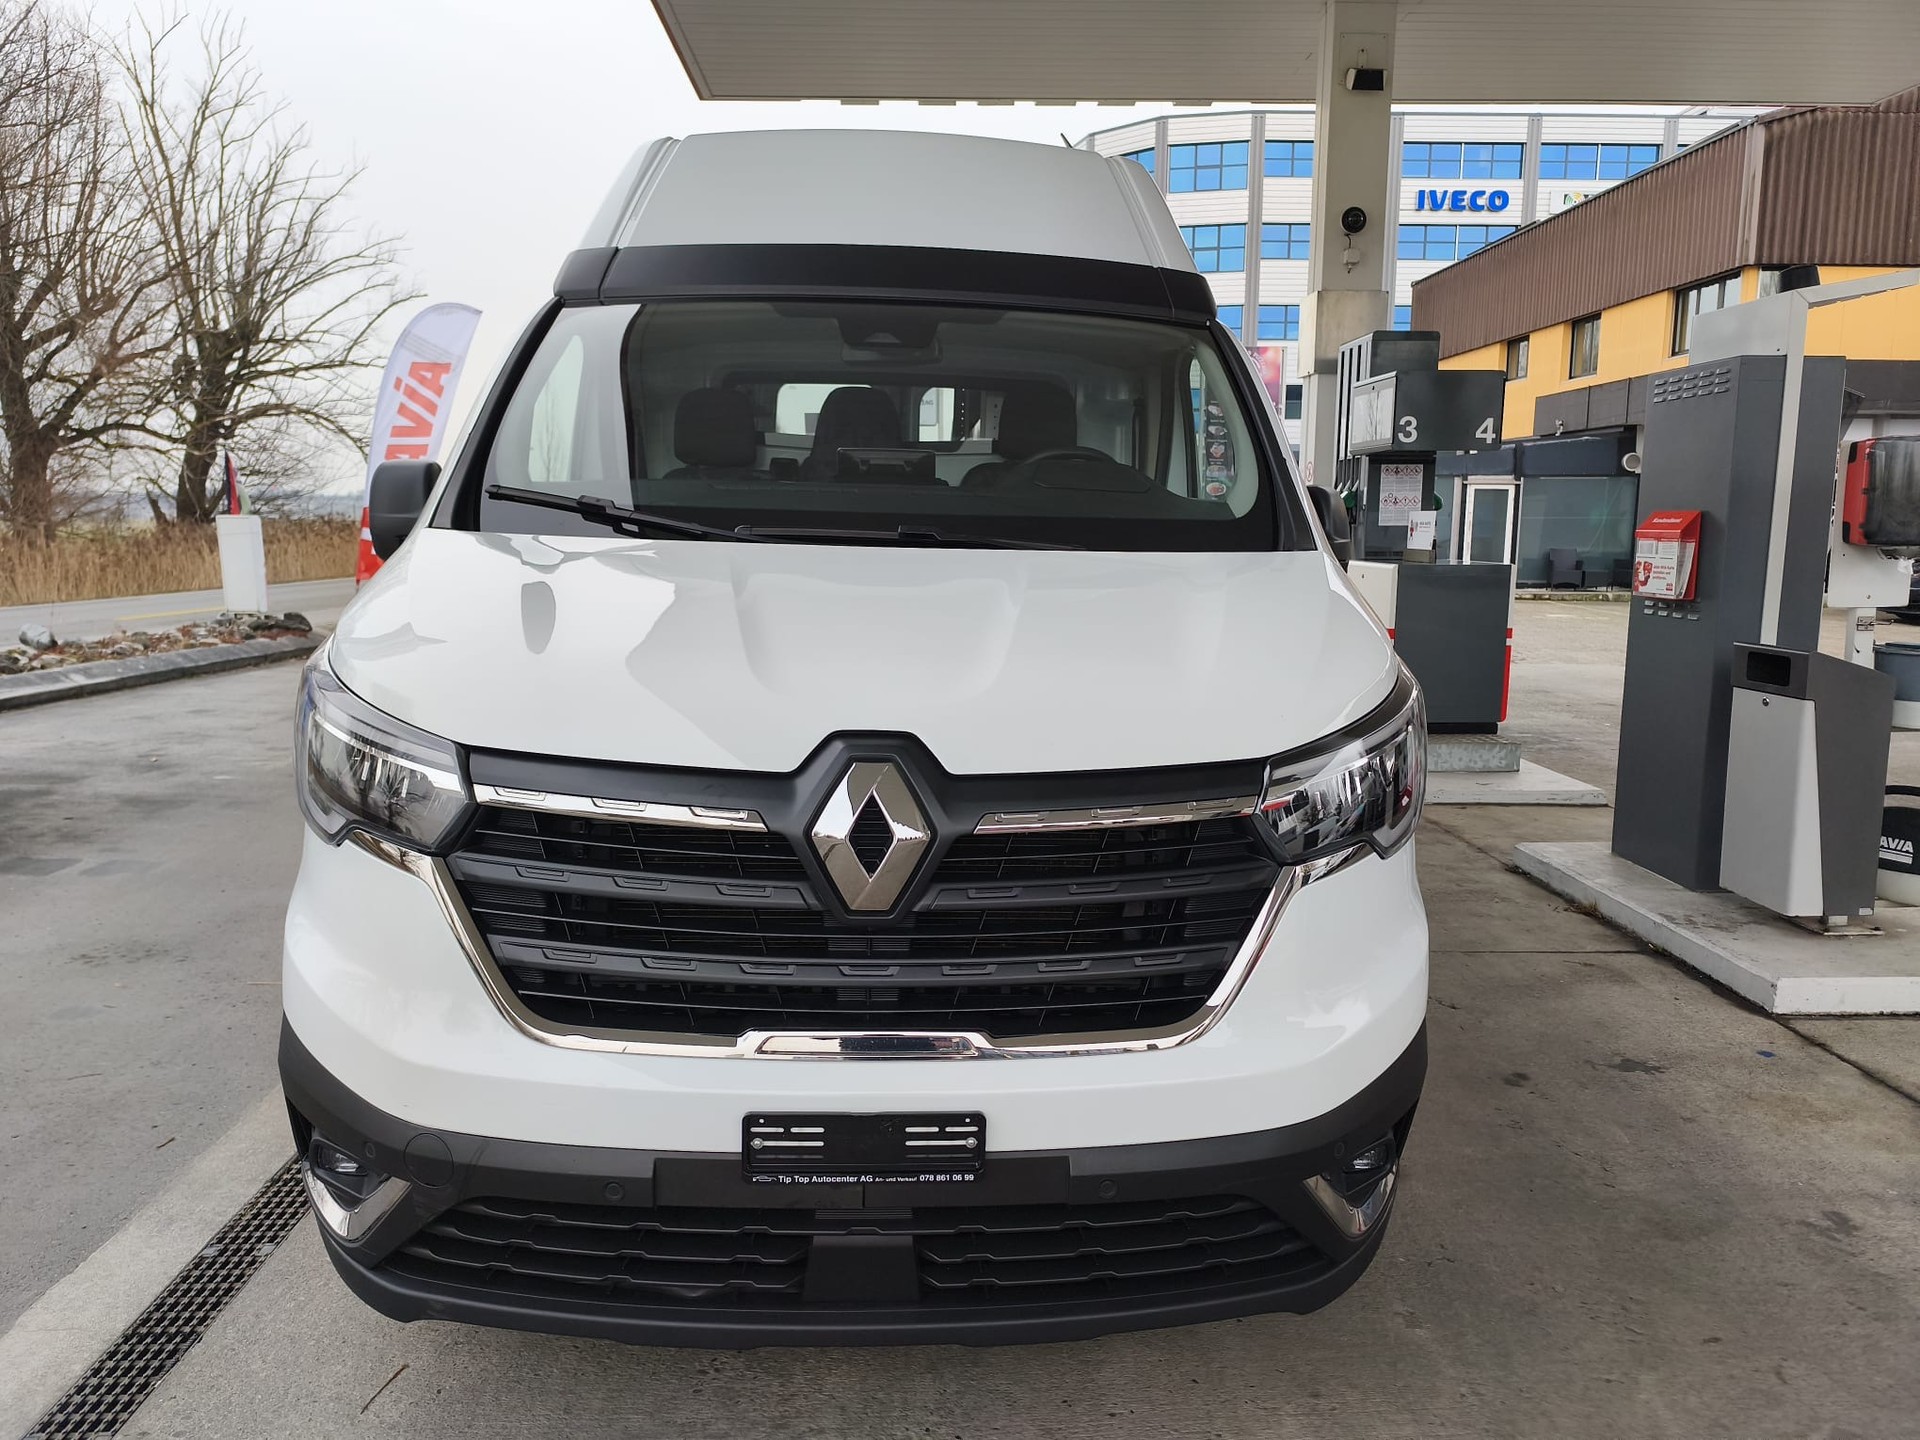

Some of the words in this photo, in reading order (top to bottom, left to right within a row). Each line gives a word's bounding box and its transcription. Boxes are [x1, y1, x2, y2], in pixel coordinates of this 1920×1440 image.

[1416, 190, 1510, 213] IVECO
[1397, 415, 1418, 444] 3
[1475, 417, 1496, 444] 4
[1880, 835, 1913, 853] AVIA
[778, 1175, 792, 1184] Tip
[793, 1175, 810, 1184] Top
[811, 1175, 859, 1183] Autocenter
[860, 1175, 873, 1183] AG
[920, 1174, 934, 1182] 078
[936, 1174, 950, 1182] 861
